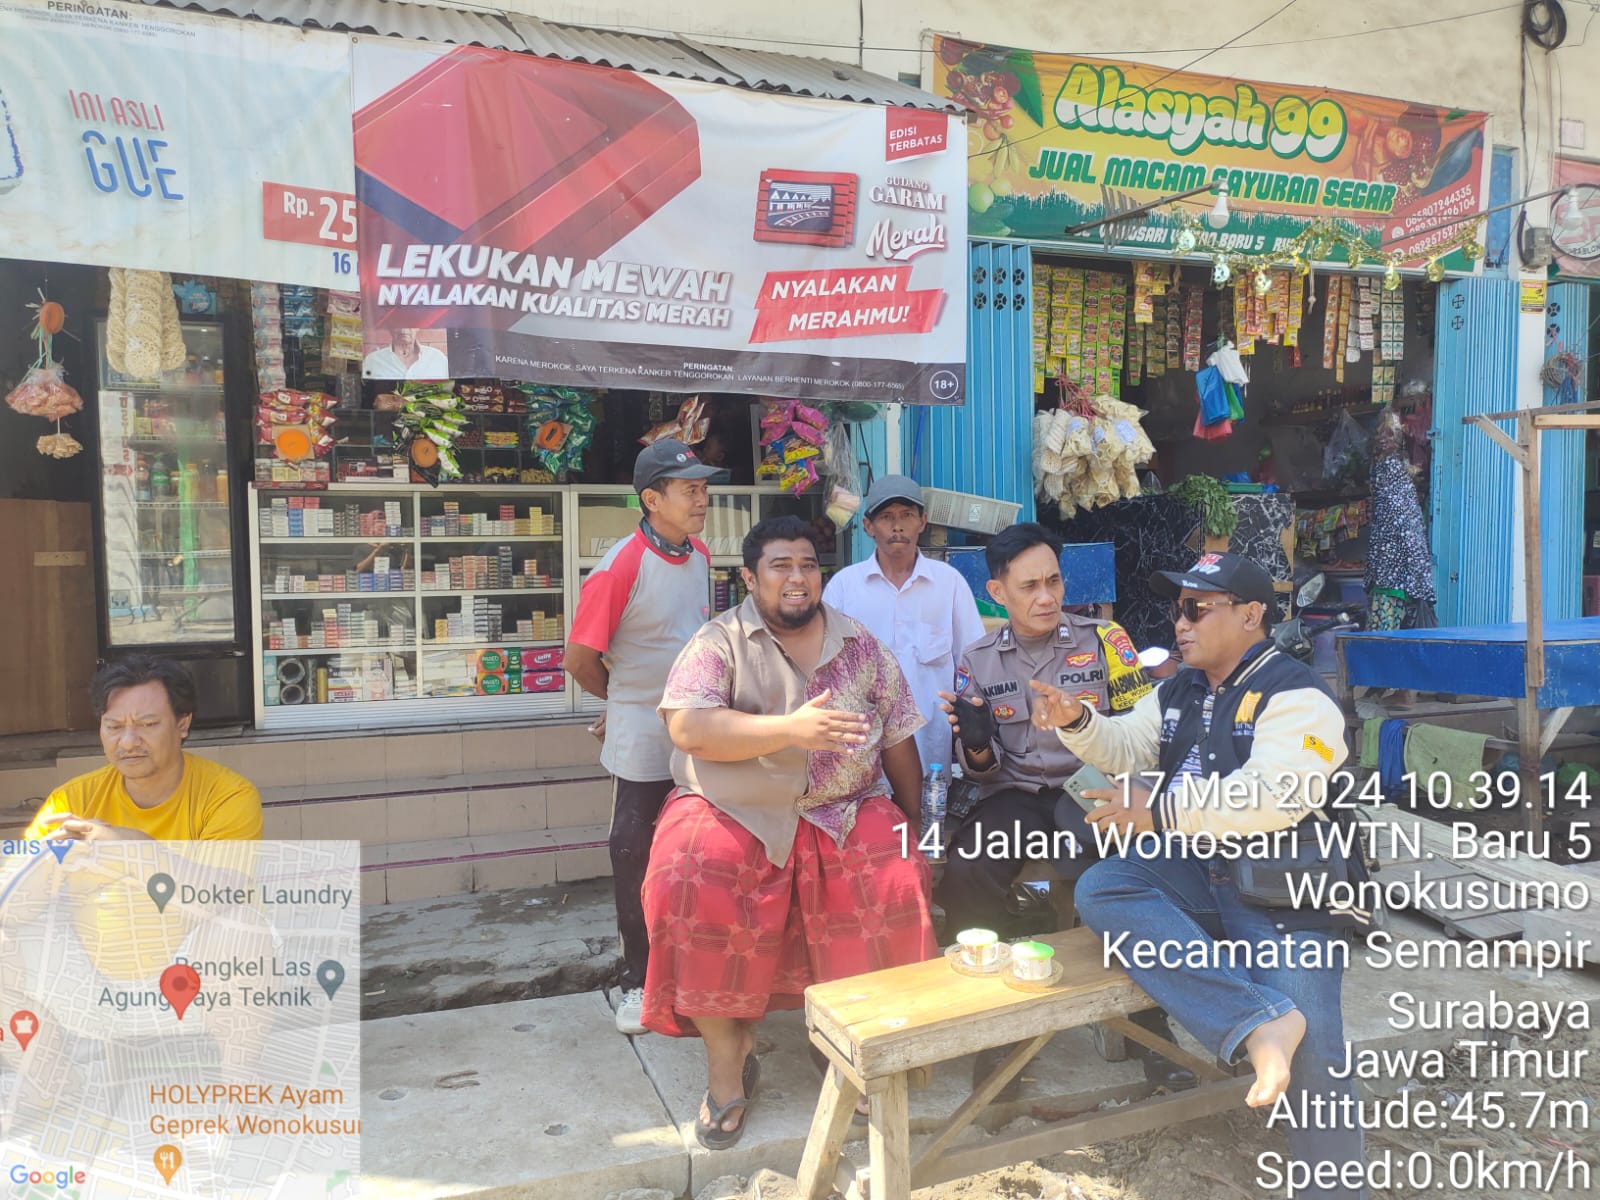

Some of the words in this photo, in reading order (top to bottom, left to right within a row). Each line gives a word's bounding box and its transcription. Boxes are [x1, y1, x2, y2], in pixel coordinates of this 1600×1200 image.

[69, 89, 106, 122] INI
[112, 97, 165, 131] ASLI
[889, 126, 917, 140] EDISI
[1270, 95, 1348, 162] 99
[889, 134, 943, 153] TERBATAS
[82, 130, 184, 200] GUE
[884, 176, 929, 191] GUDANG
[1029, 149, 1097, 183] JUAL
[1103, 156, 1206, 192] MACAM
[1321, 179, 1398, 213] SEGAR
[868, 185, 946, 210] GARAM
[283, 191, 315, 219] Rp.
[319, 196, 358, 243] 25
[866, 214, 945, 258] Merah
[1218, 233, 1254, 249] BARU
[1255, 236, 1265, 250] 5
[376, 244, 574, 288] LEKUKAN
[581, 258, 733, 302] MEWAH
[771, 274, 898, 300] NYALAKAN
[378, 283, 516, 309] NYALAKAN
[521, 291, 642, 321] KUALITAS
[645, 302, 732, 328] MERAH
[788, 306, 910, 331] MERAHMU!
[495, 355, 529, 366] KARENA
[575, 364, 597, 372] SAYA
[599, 366, 637, 375] TERKENA
[738, 373, 774, 382] LAYANAN
[774, 375, 814, 385] BERHENTI
[814, 377, 850, 388] MEROKOK
[933, 378, 955, 391] 18+
[1060, 669, 1104, 685] POLRI
